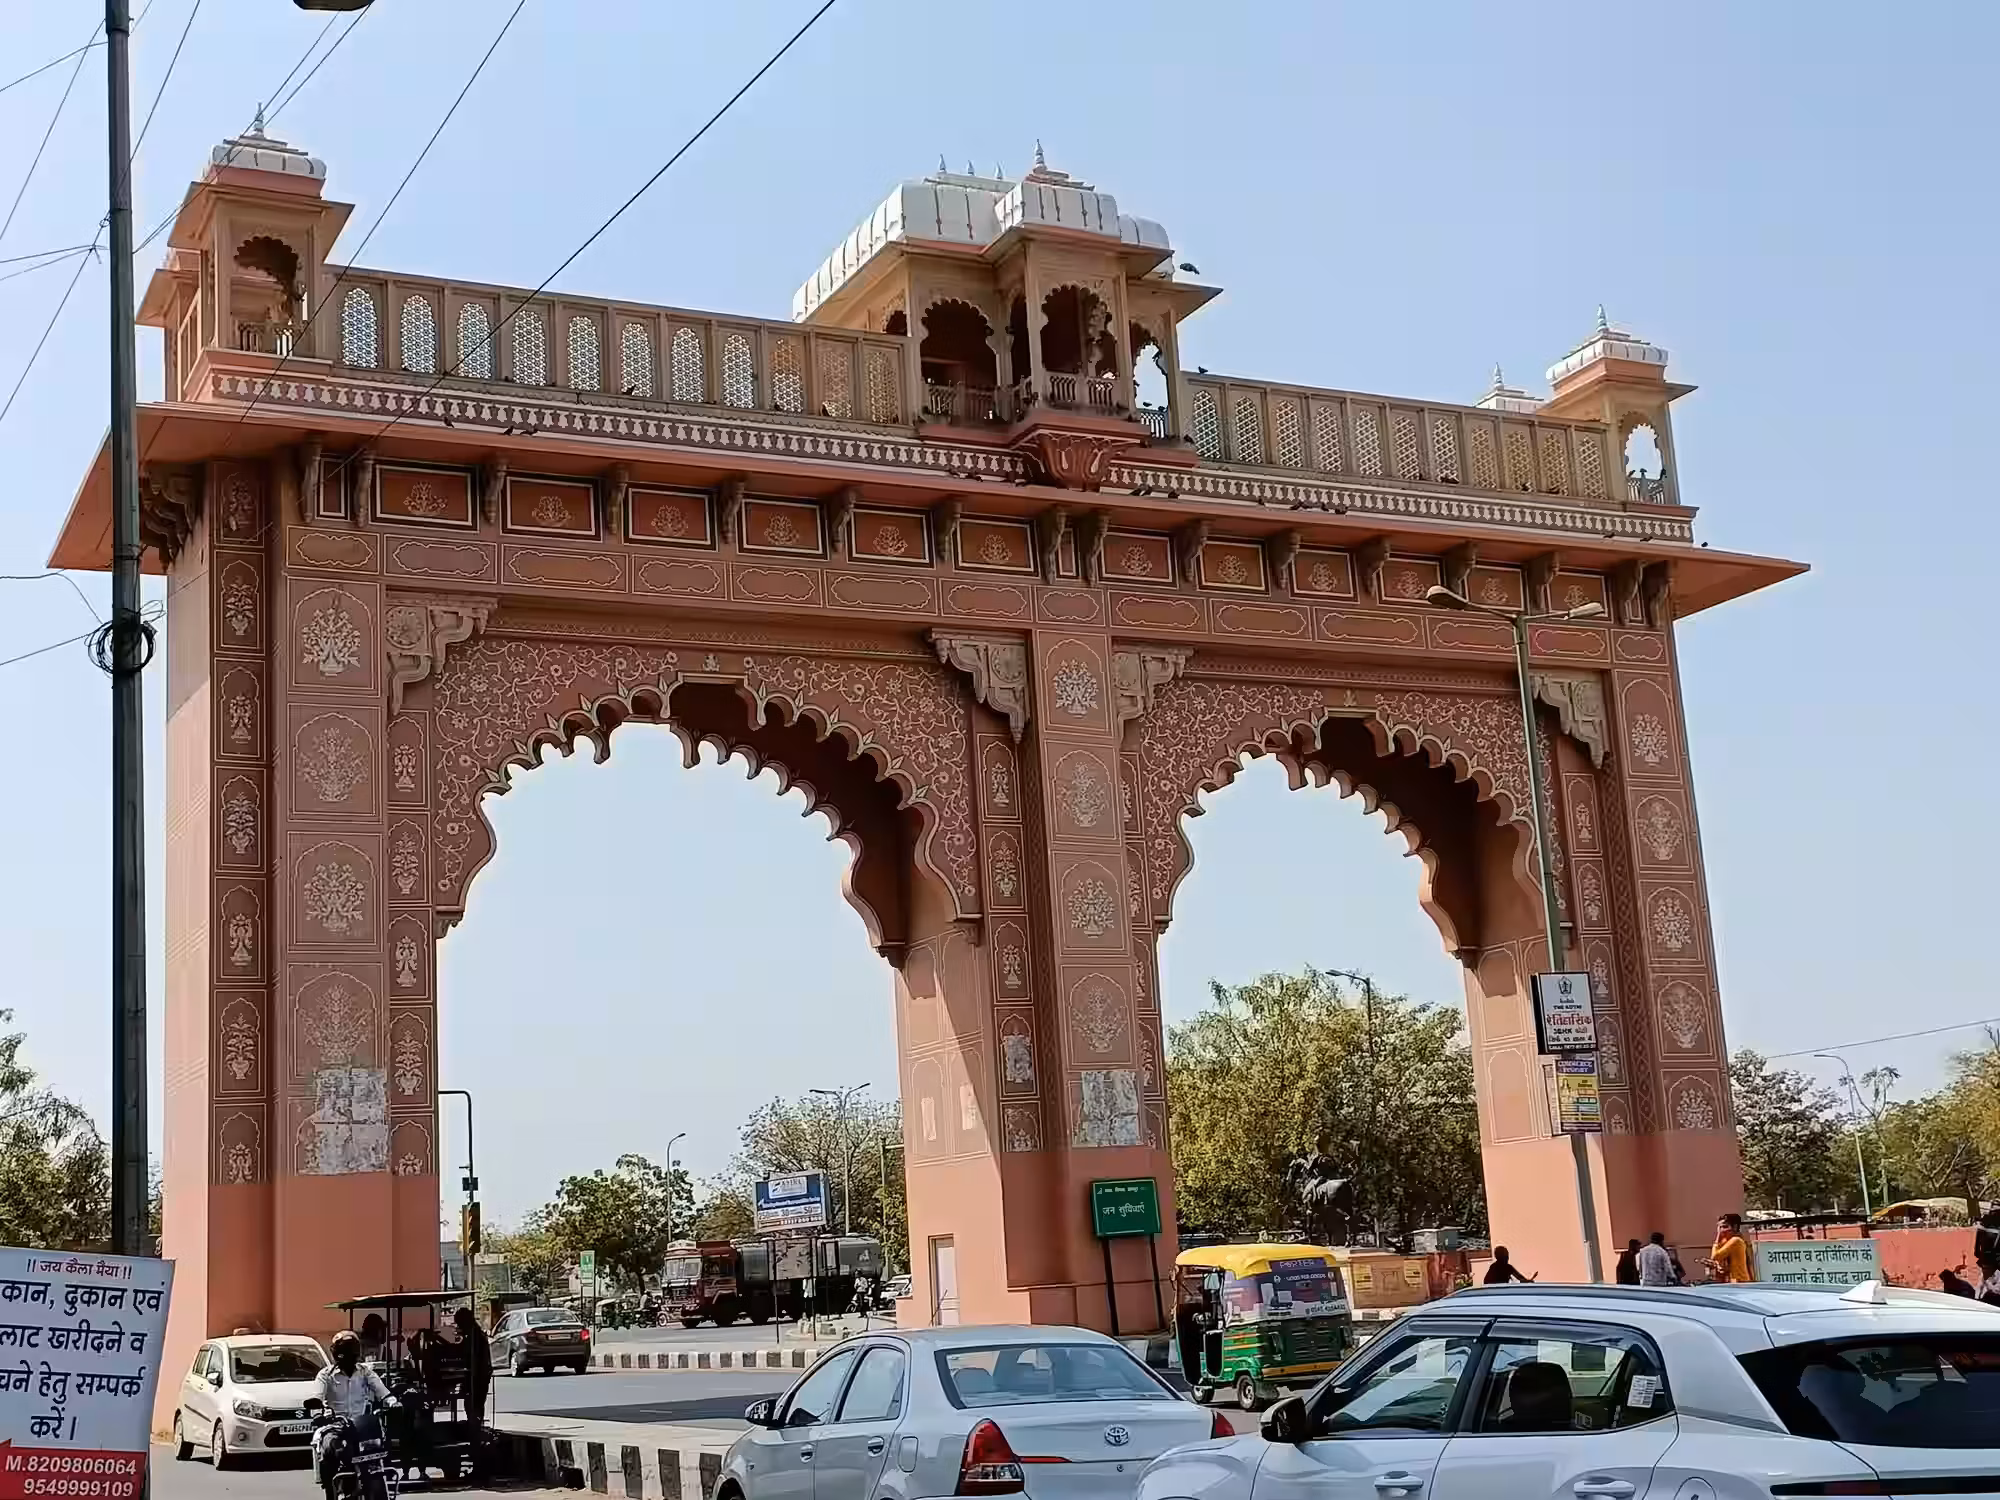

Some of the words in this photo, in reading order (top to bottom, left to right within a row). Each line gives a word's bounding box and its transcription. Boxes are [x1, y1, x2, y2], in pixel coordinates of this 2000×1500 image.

[1102, 1206, 1115, 1215] जन
[1768, 1249, 1802, 1263] आसाम
[1803, 1250, 1812, 1262] व
[40, 1260, 62, 1272] जय
[64, 1258, 93, 1275] कैला
[96, 1260, 120, 1277] मैया
[0, 1280, 55, 1311] कान,
[64, 1283, 128, 1316] दुकान
[133, 1281, 165, 1315] एवं
[48, 1319, 125, 1354] खरीदने
[130, 1331, 147, 1354] व
[39, 1361, 71, 1405] हेतु
[76, 1366, 146, 1397] सम्पर्क
[31, 1407, 65, 1438] करें
[5, 1455, 136, 1475] M.8209806064
[24, 1478, 133, 1497] 9549999109
